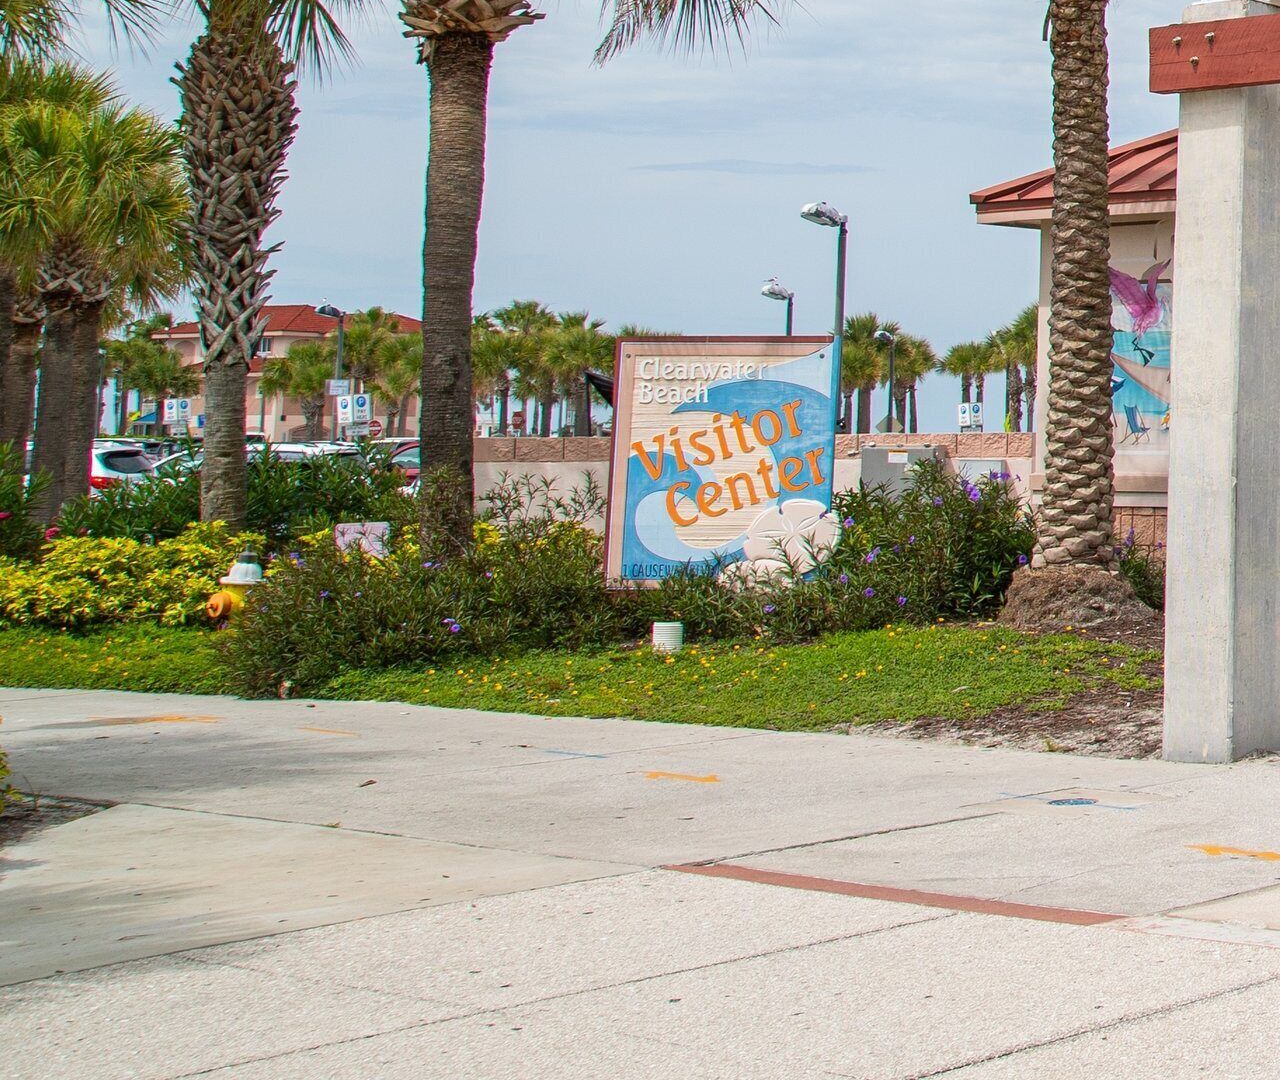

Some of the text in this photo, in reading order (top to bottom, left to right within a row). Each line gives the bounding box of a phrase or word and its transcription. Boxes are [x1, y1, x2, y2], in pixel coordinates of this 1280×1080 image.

[638, 358, 768, 381] Clearwater
[638, 381, 709, 405] Beach
[631, 399, 803, 481] Visitor
[665, 447, 826, 527] Center
